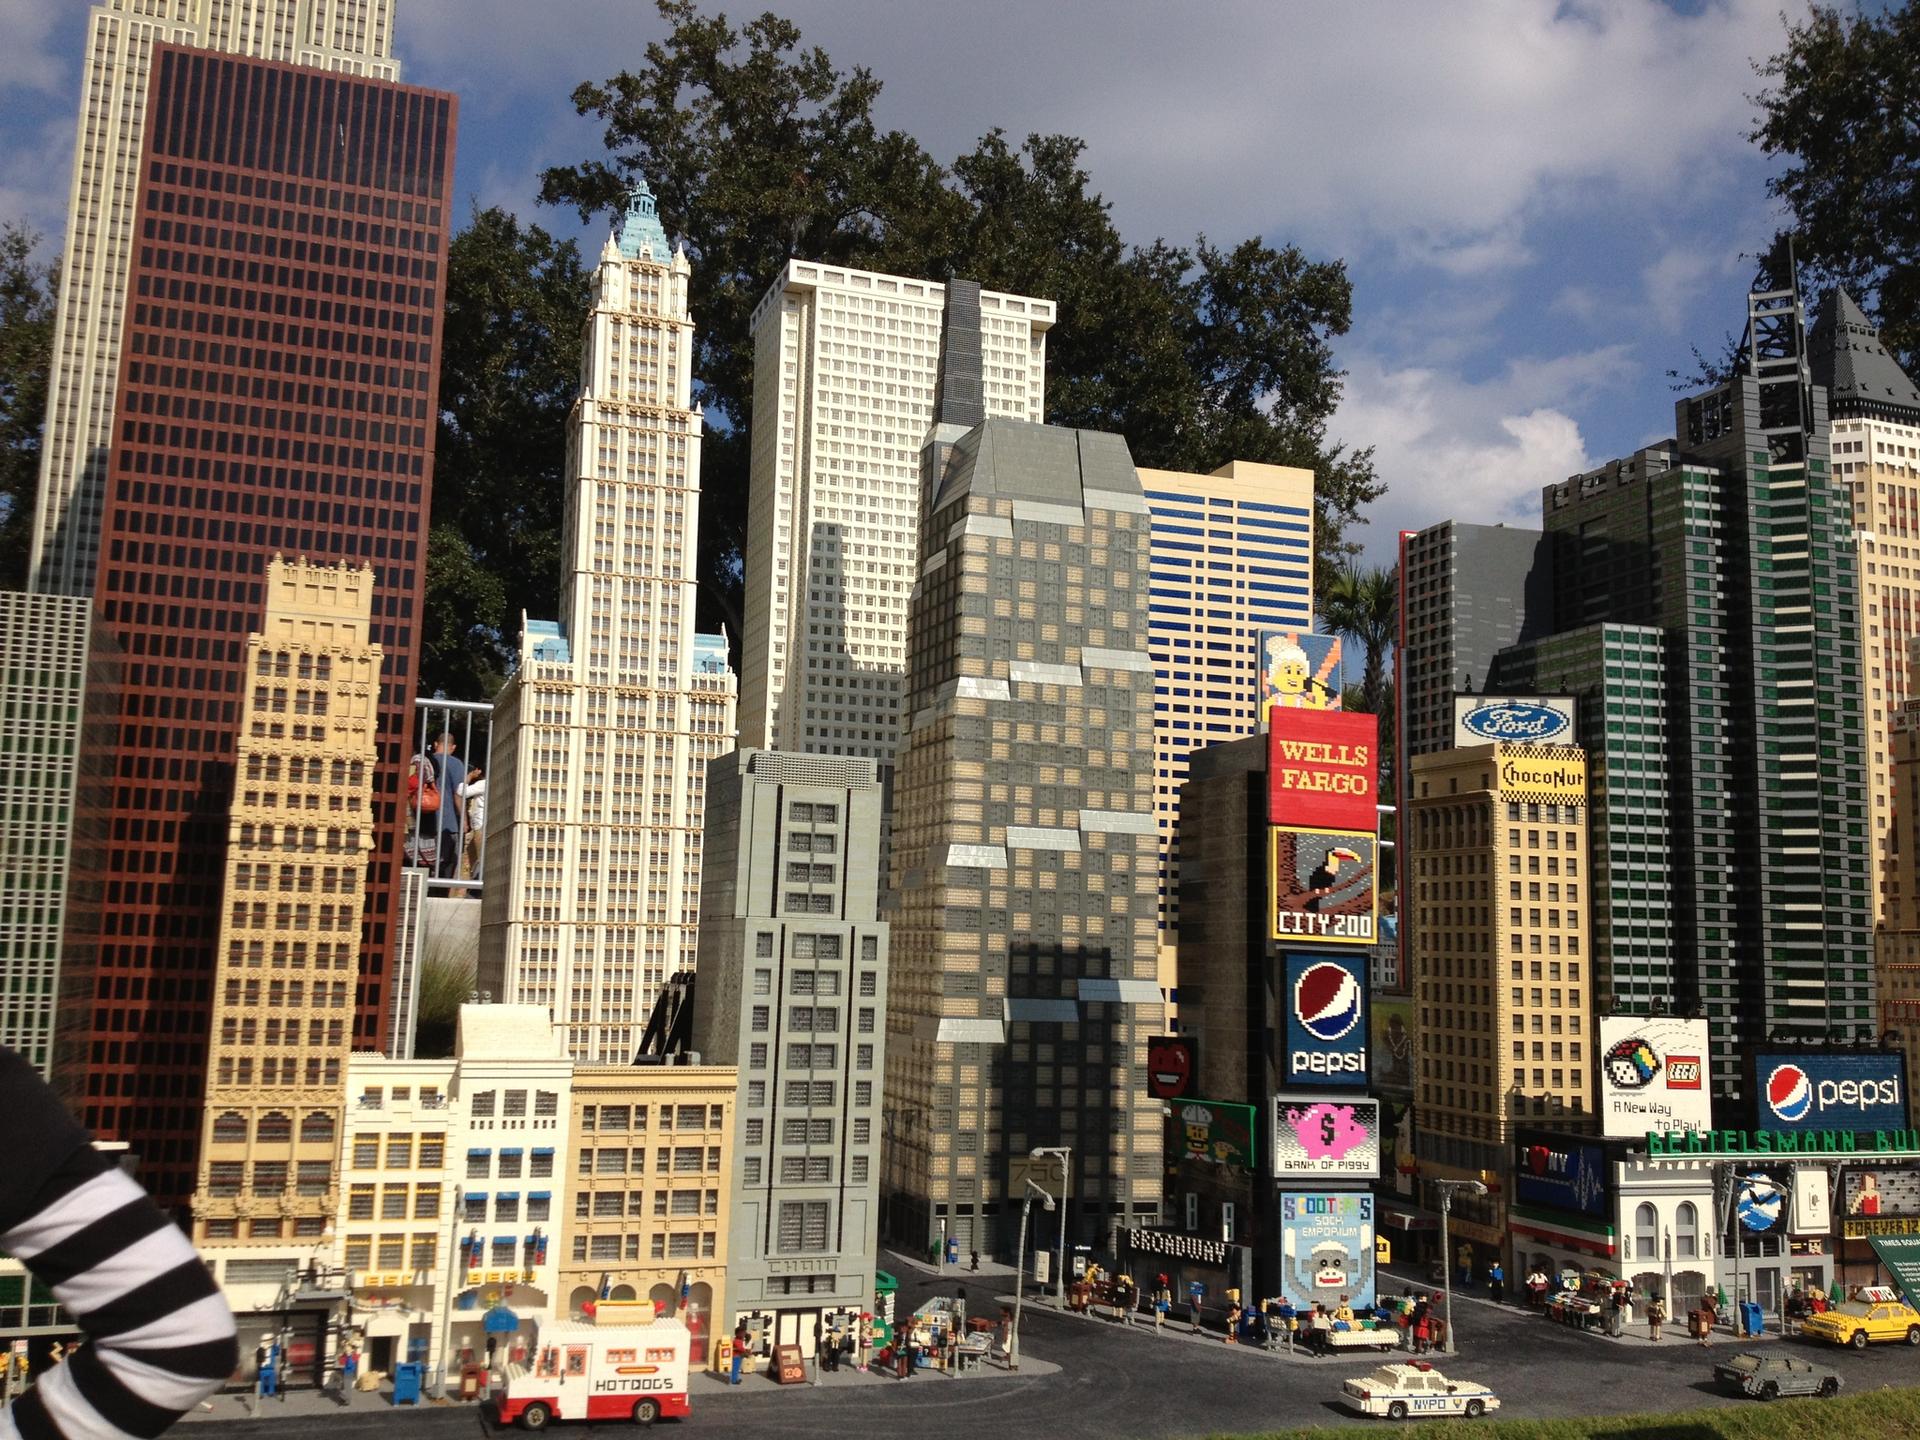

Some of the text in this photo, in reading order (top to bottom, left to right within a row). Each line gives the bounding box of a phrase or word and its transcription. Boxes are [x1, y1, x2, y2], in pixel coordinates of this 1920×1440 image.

[1483, 709, 1547, 734] Ford
[1279, 739, 1368, 767] WELLS
[1281, 768, 1368, 795] FARGO
[1502, 760, 1584, 788] ChocoNut
[1278, 911, 1372, 938] CITY ZOO
[1292, 1047, 1366, 1076] pepsi
[1669, 1063, 1699, 1080] LEGO
[1817, 1074, 1899, 1112] pepsi
[1613, 1101, 1672, 1117] A New Way
[1654, 1118, 1702, 1135] to Play!
[1646, 1129, 1856, 1154] BERTELSMANN
[1284, 1160, 1316, 1170] BANK
[1321, 1160, 1334, 1170] OF
[1521, 1146, 1569, 1173] I NY
[1301, 1226, 1358, 1237] EMPORIUM
[1314, 1216, 1344, 1226] SOCK
[1847, 1219, 1904, 1237] FOREVER
[1130, 1227, 1226, 1265] BROADWAY
[1878, 1239, 1902, 1247] TIMES
[1414, 1399, 1446, 1410] NYPD
